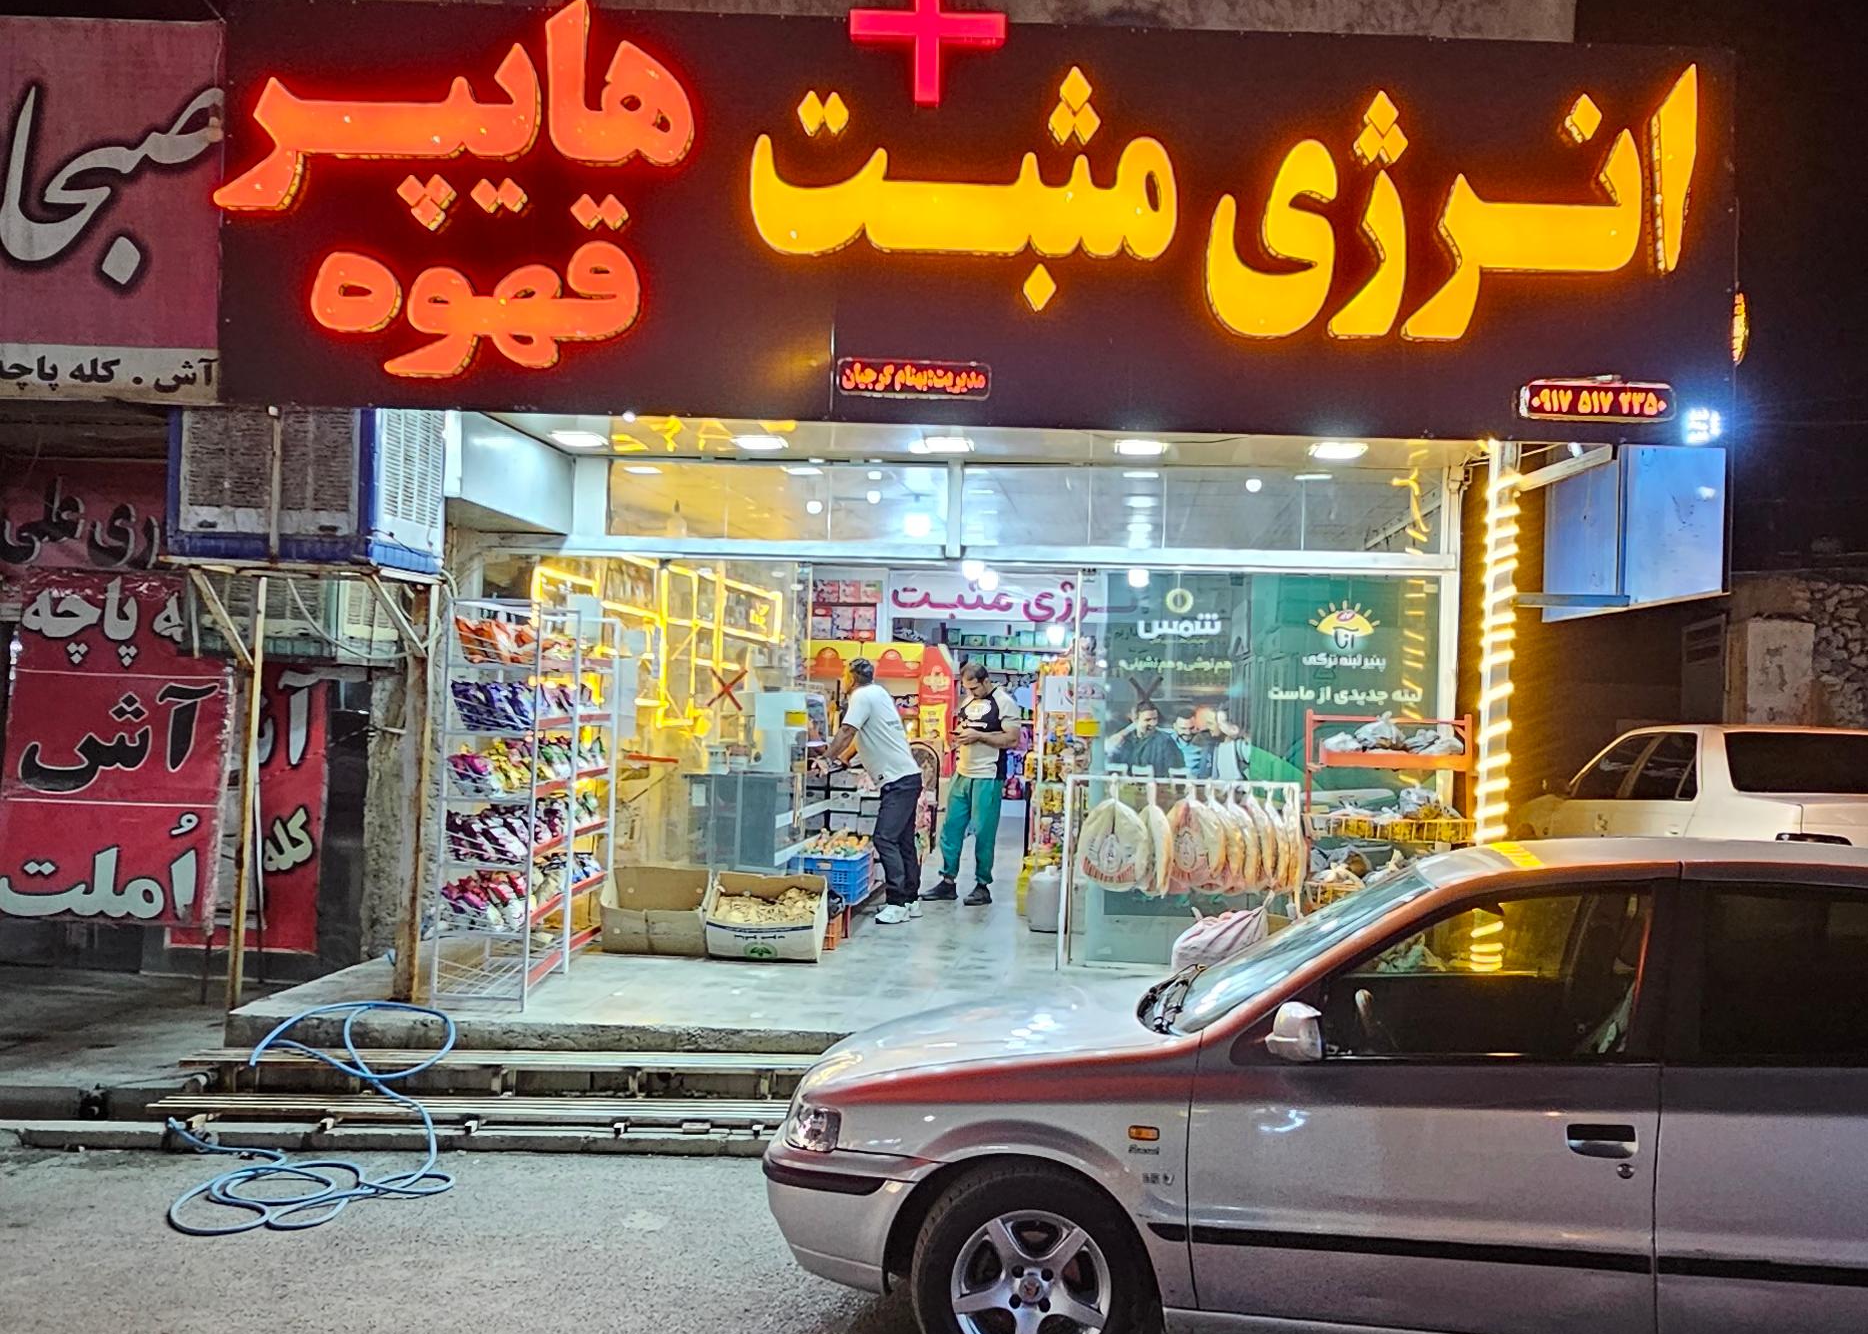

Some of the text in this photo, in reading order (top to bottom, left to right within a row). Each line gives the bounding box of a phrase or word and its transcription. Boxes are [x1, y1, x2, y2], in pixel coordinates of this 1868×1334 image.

[750, 63, 1699, 341] انرژی مثبت
[310, 193, 641, 379] قهوه
[69, 357, 121, 383] کله
[153, 357, 219, 393] آش
[1577, 390, 1614, 414] ۵۱۷
[21, 575, 138, 667] پاچه
[1137, 612, 1222, 640] شمس
[1267, 685, 1316, 701] ماست
[1316, 686, 1332, 705] از
[1334, 688, 1389, 706] جدیدی
[18, 682, 219, 795] آش
[263, 806, 314, 872] کله
